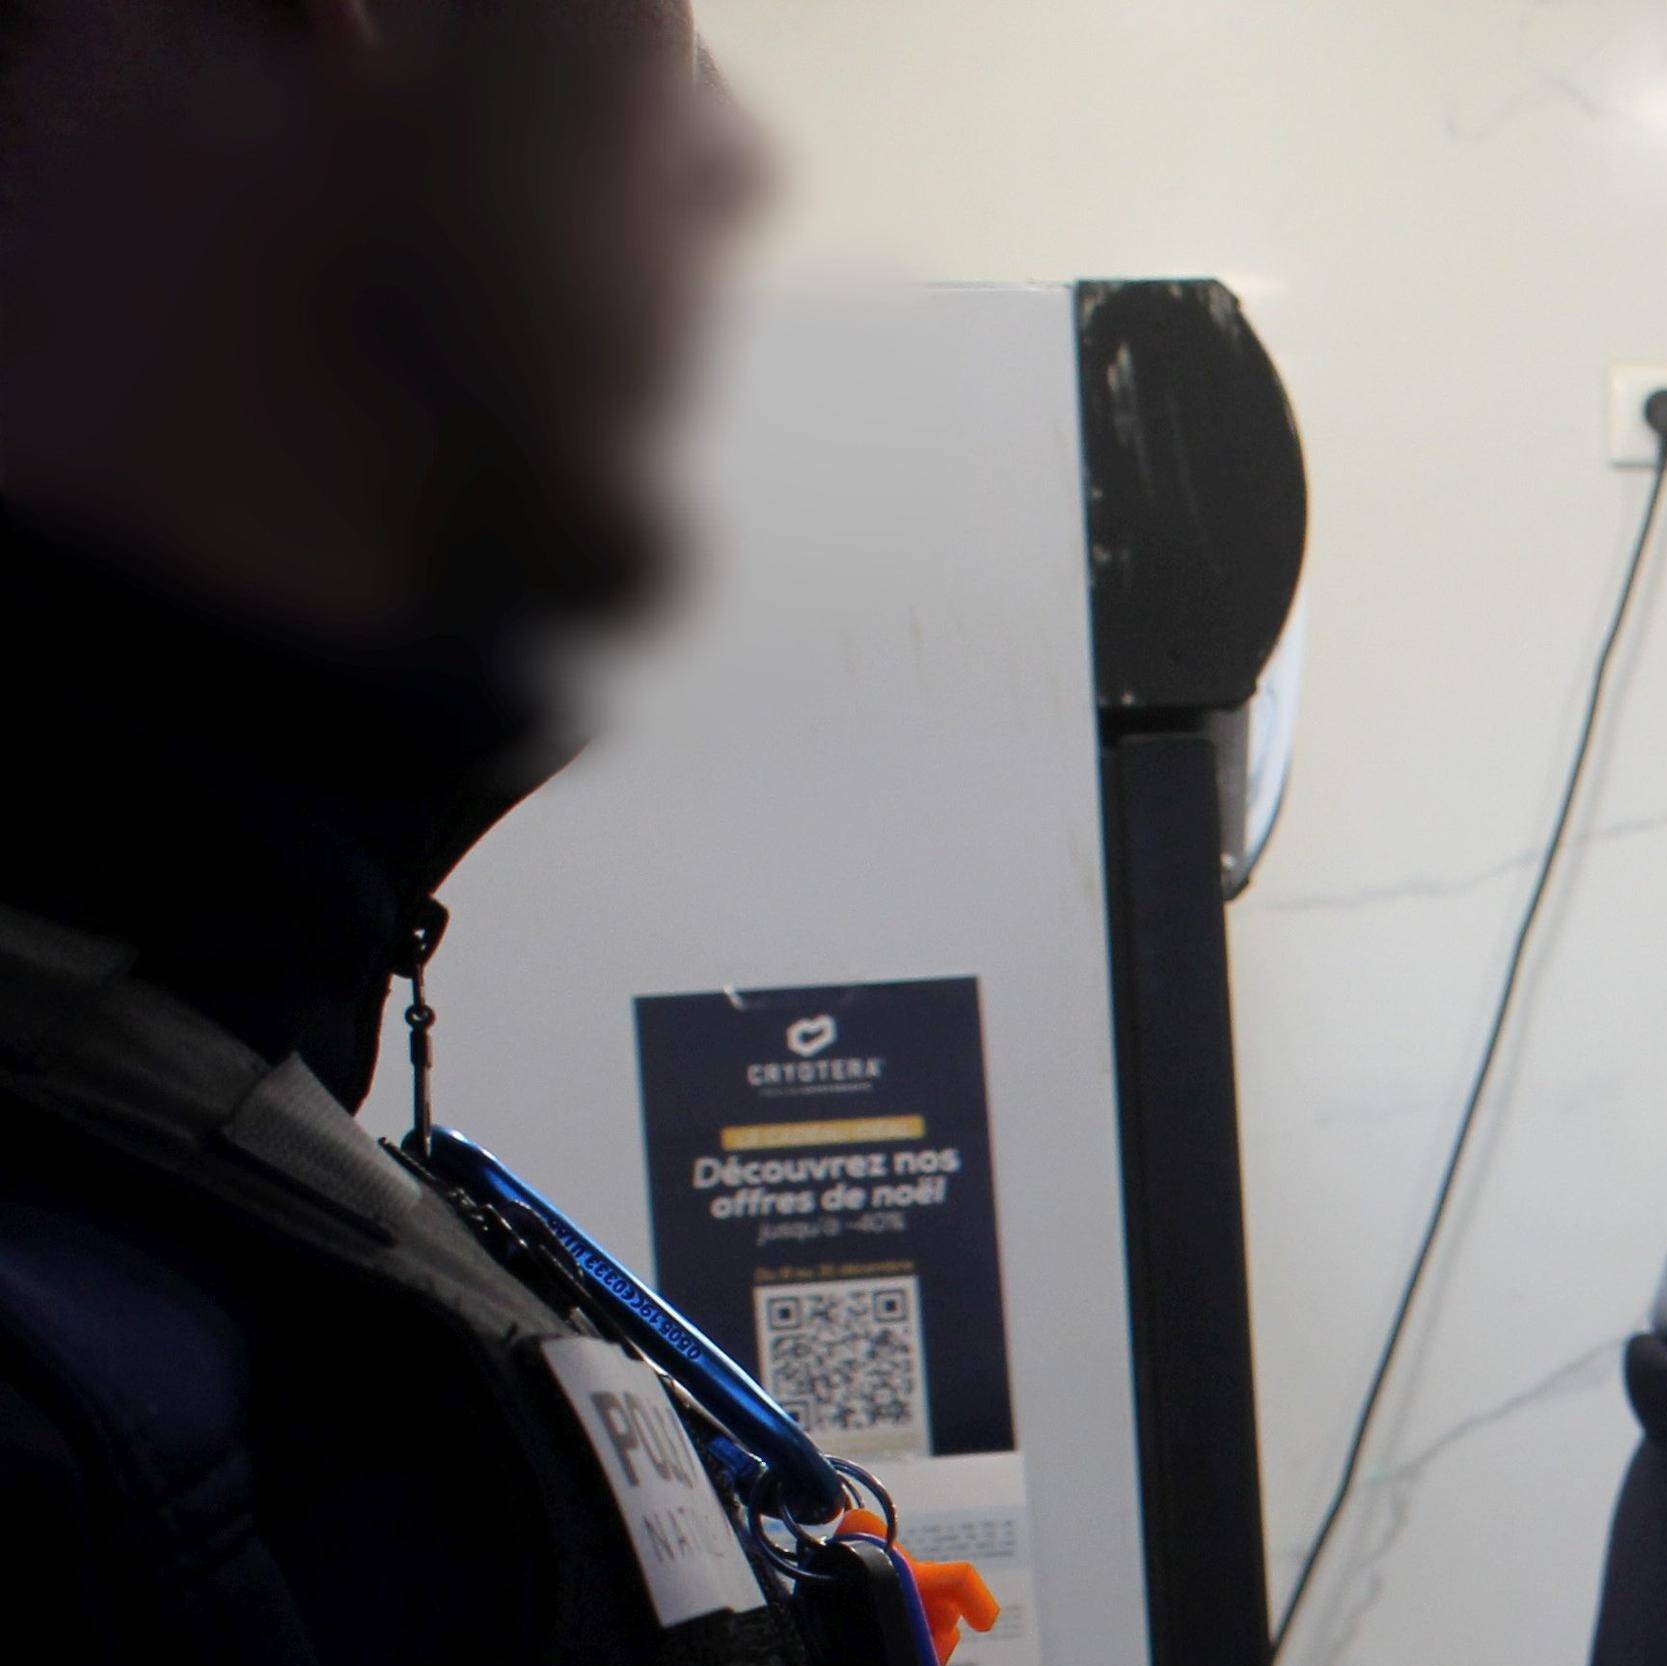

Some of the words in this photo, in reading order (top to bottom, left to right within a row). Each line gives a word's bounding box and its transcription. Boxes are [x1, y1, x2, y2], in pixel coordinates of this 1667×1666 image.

[692, 1150, 889, 1189] Découvrez
[893, 1147, 962, 1177] nos
[709, 1185, 816, 1221] offres
[820, 1182, 867, 1211] de
[871, 1175, 948, 1208] noël
